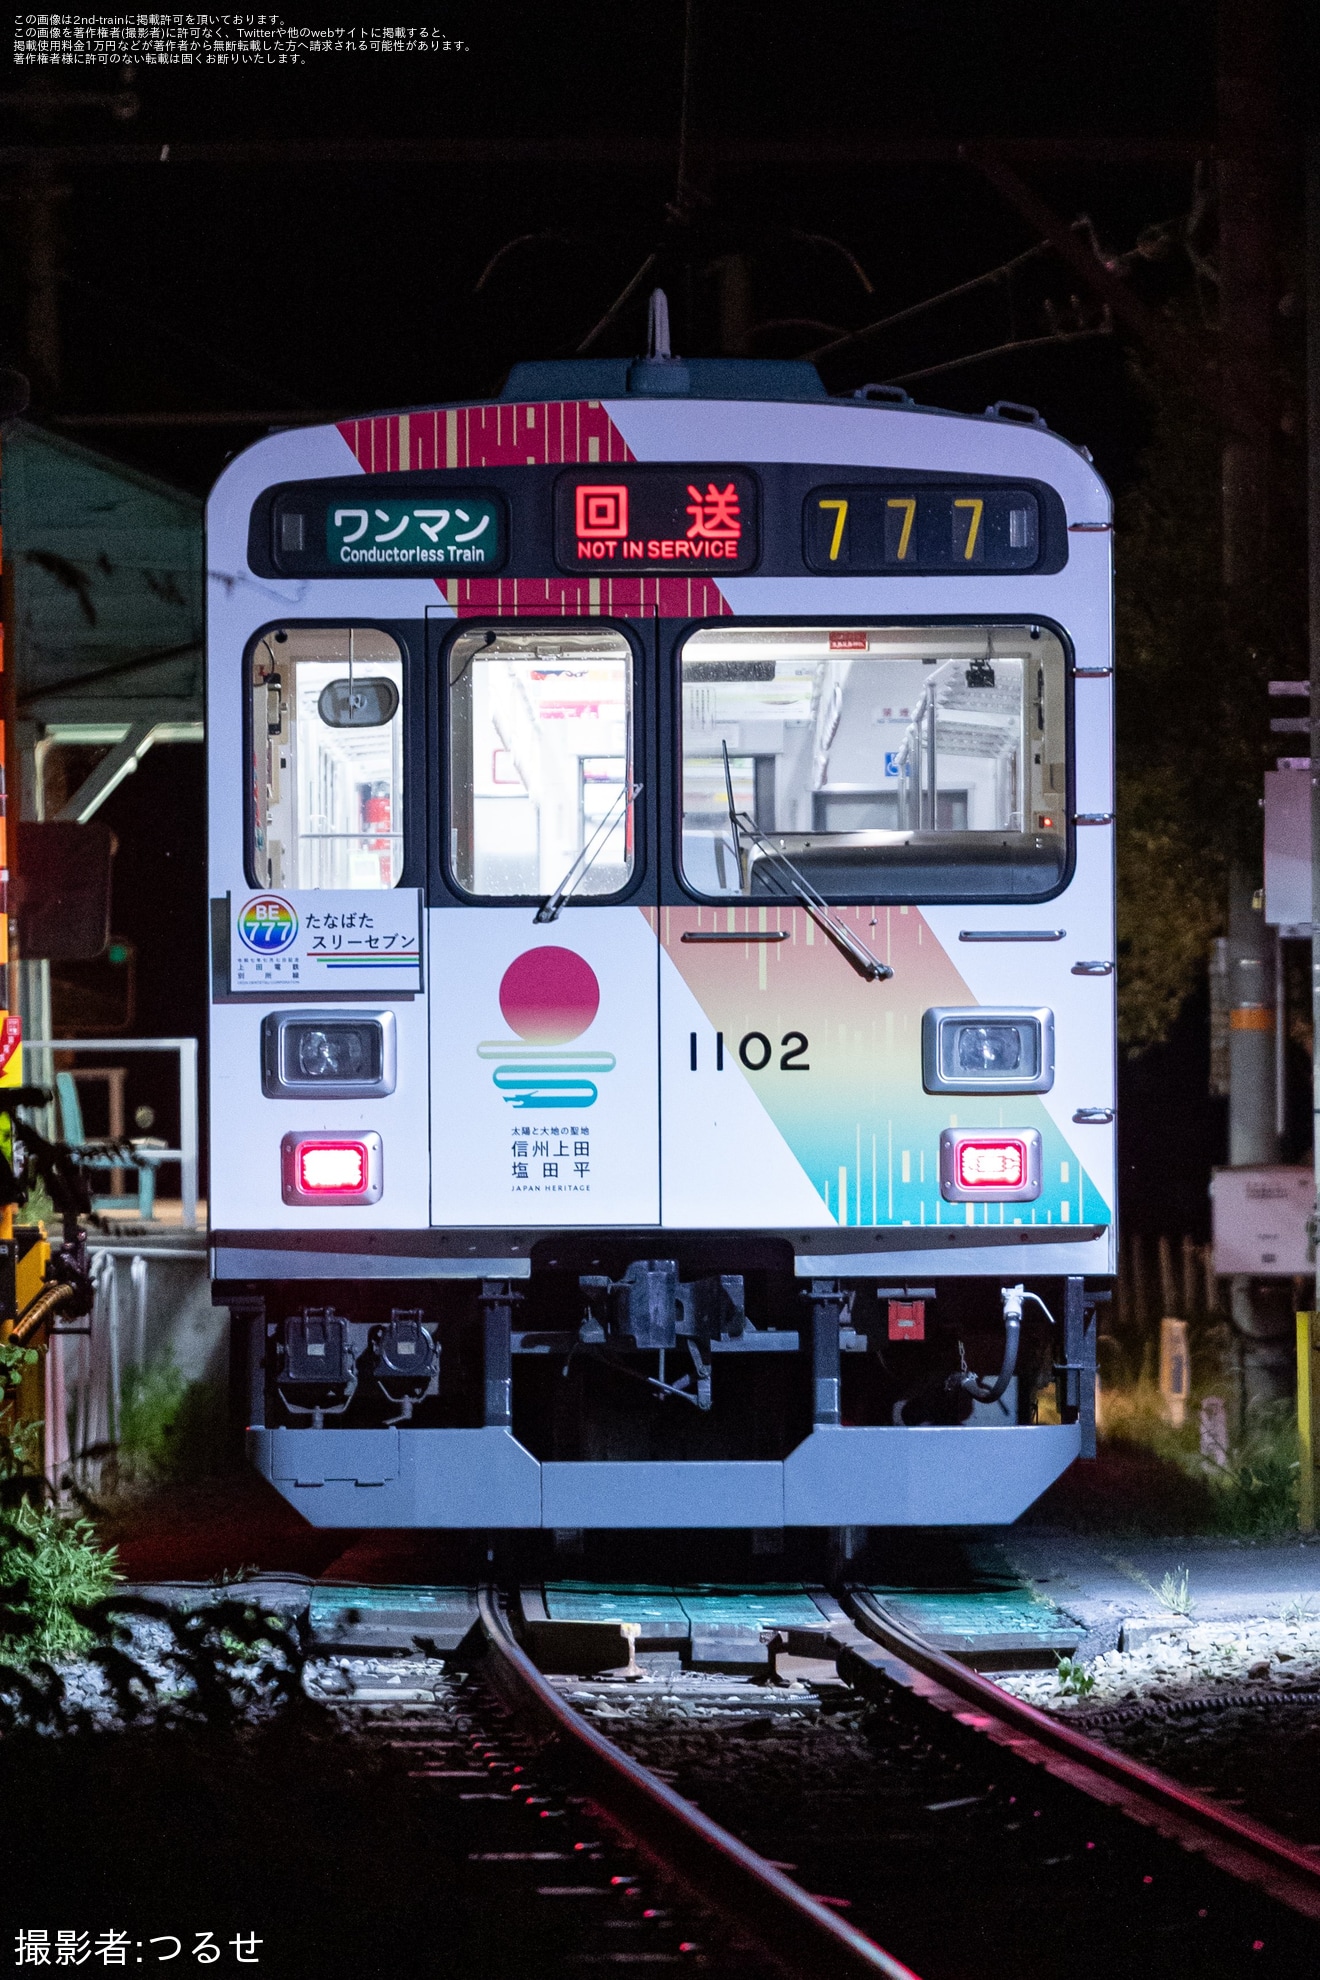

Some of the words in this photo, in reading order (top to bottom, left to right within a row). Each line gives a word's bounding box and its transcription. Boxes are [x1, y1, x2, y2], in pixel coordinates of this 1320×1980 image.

[334, 508, 490, 543] ワンマン
[340, 545, 445, 563] Conductorless
[447, 545, 485, 562] Train
[577, 540, 618, 559] NOT
[623, 540, 643, 559] IN
[647, 540, 738, 559] SERVICE
[255, 904, 280, 921] BE
[305, 912, 374, 929] たなばた
[246, 922, 291, 942] 777
[312, 933, 415, 950] スリーセブン
[690, 1031, 811, 1071] 1102
[511, 1126, 590, 1136] 太陽と大地の聖地
[511, 1140, 590, 1158] 信州上田
[511, 1161, 591, 1179] 塩田平
[511, 1184, 541, 1192] JAPAN
[545, 1184, 591, 1192] HERITAGE
